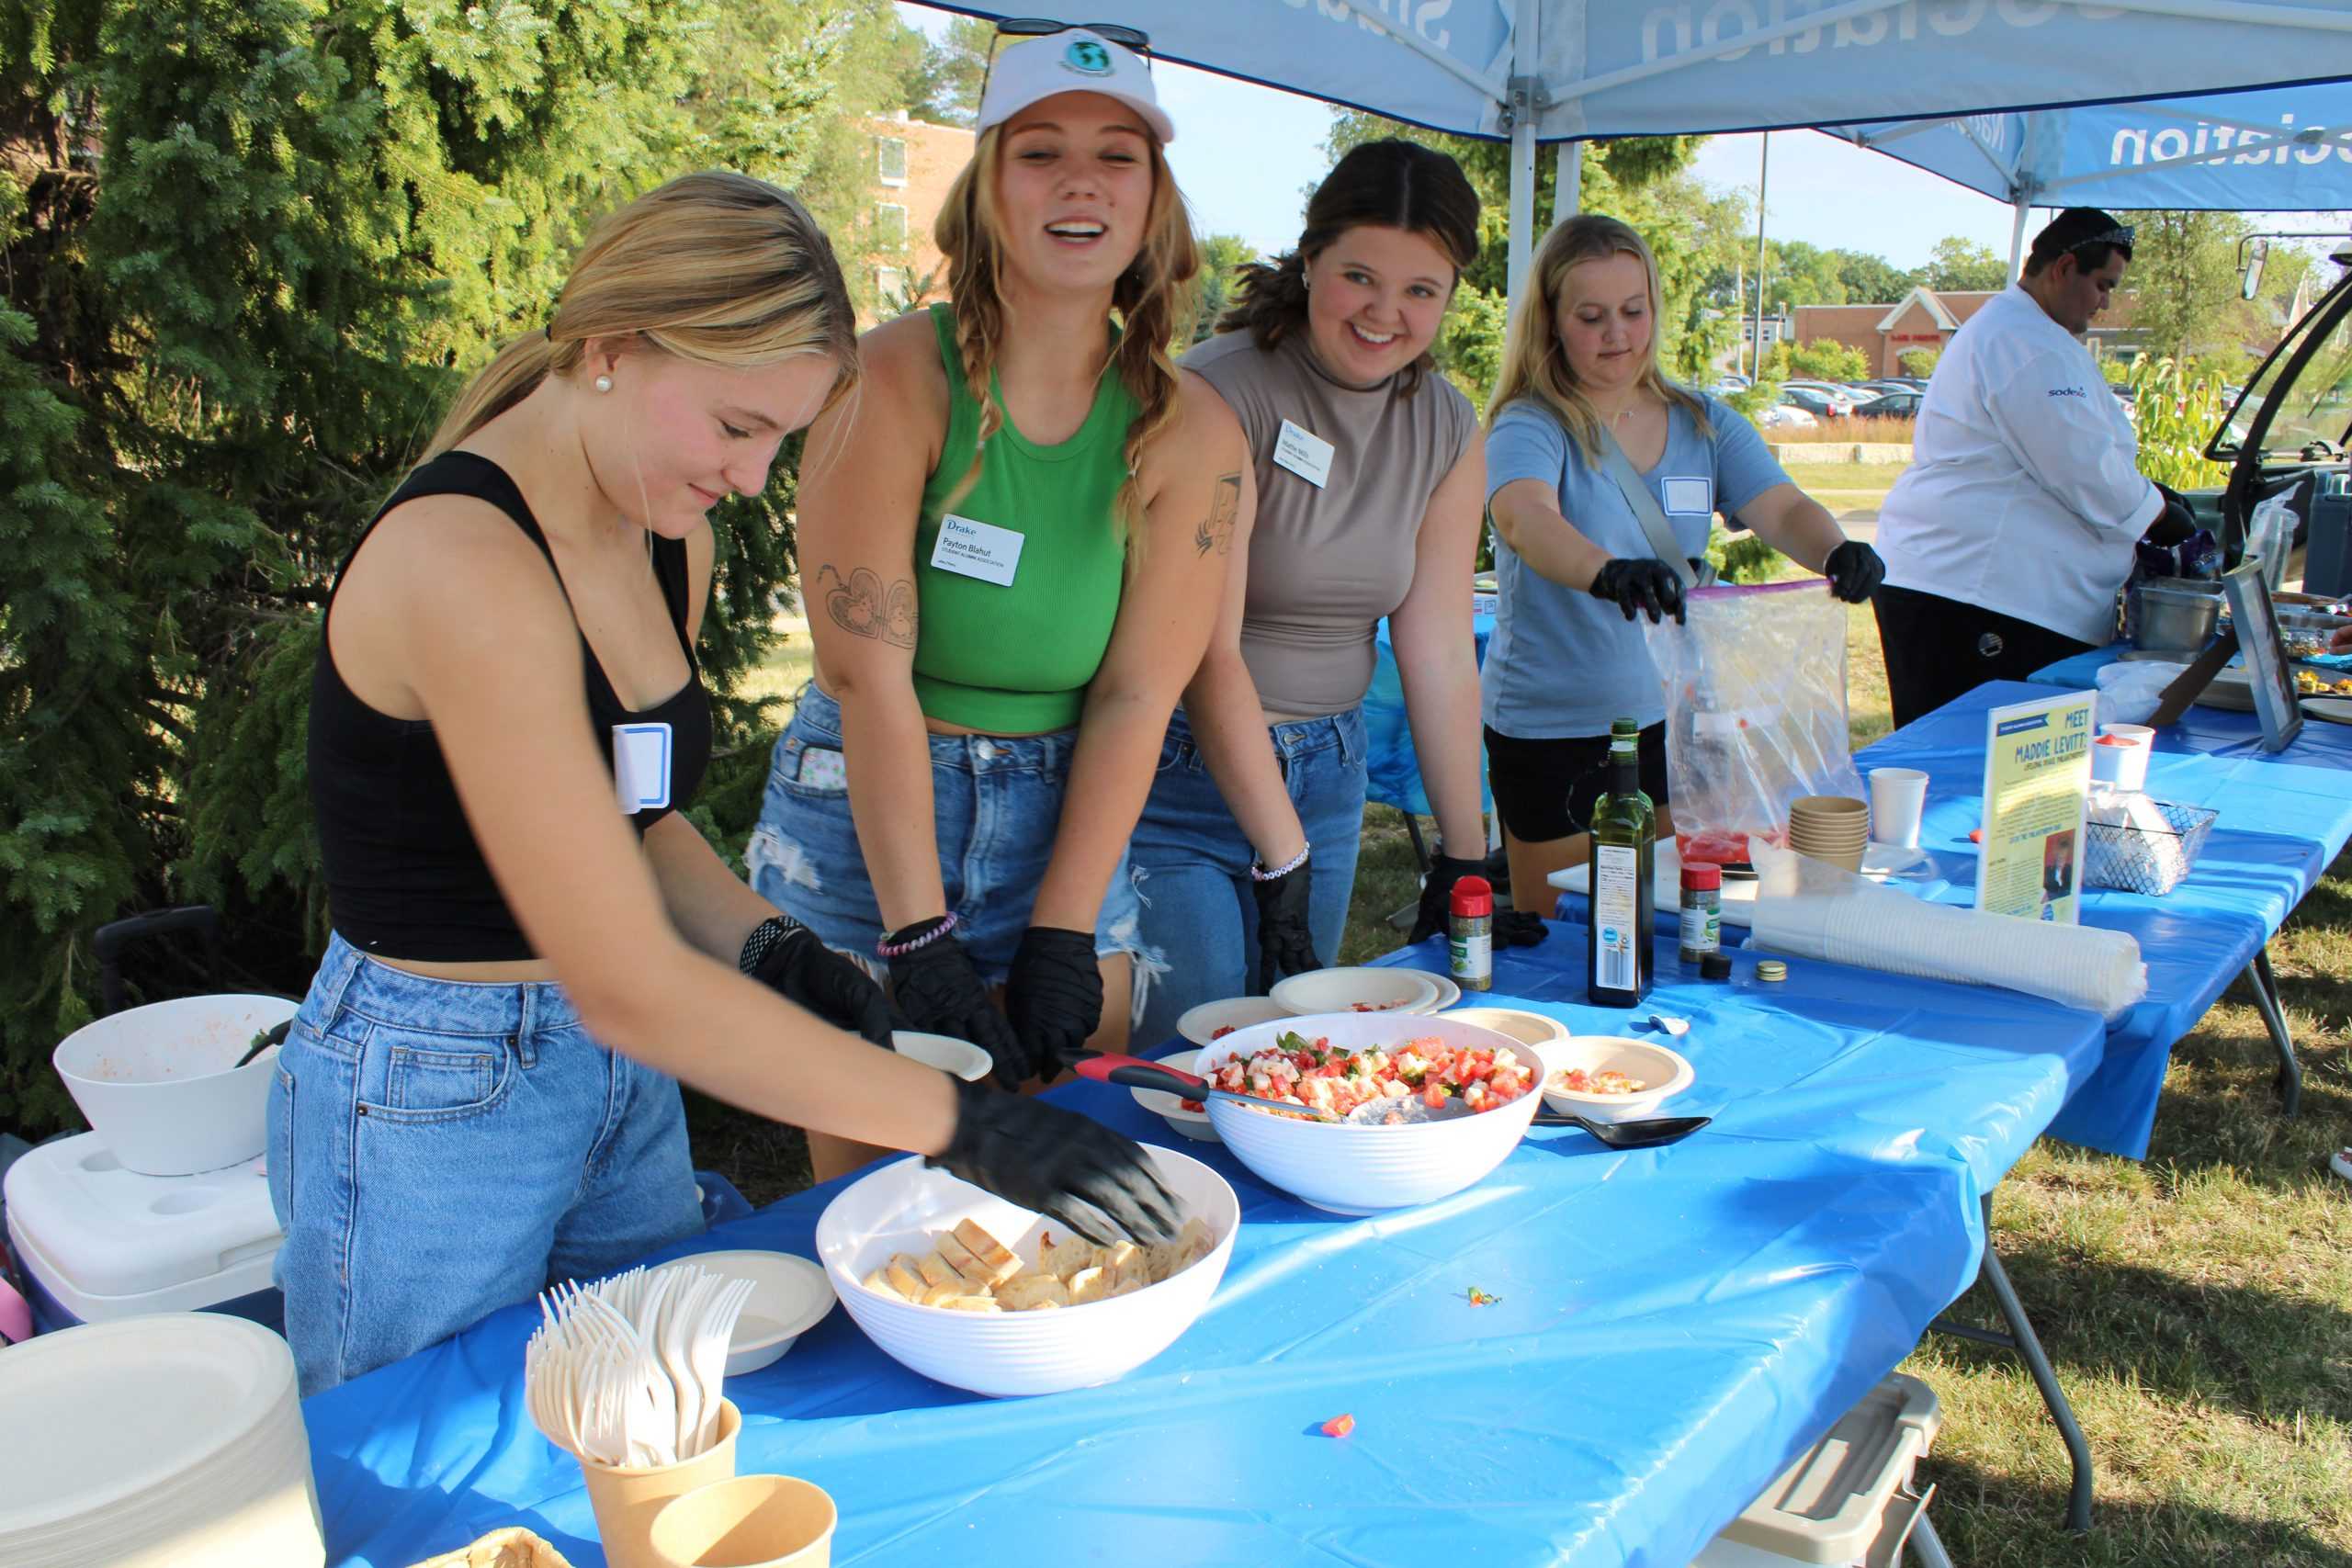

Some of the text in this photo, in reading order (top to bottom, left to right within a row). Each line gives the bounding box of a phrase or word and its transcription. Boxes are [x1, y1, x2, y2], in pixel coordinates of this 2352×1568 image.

[947, 519, 977, 536] Drake
[943, 537, 991, 558] Payton Blahut
[2064, 708, 2089, 729] MEET
[2016, 739, 2050, 764] MADDIE
